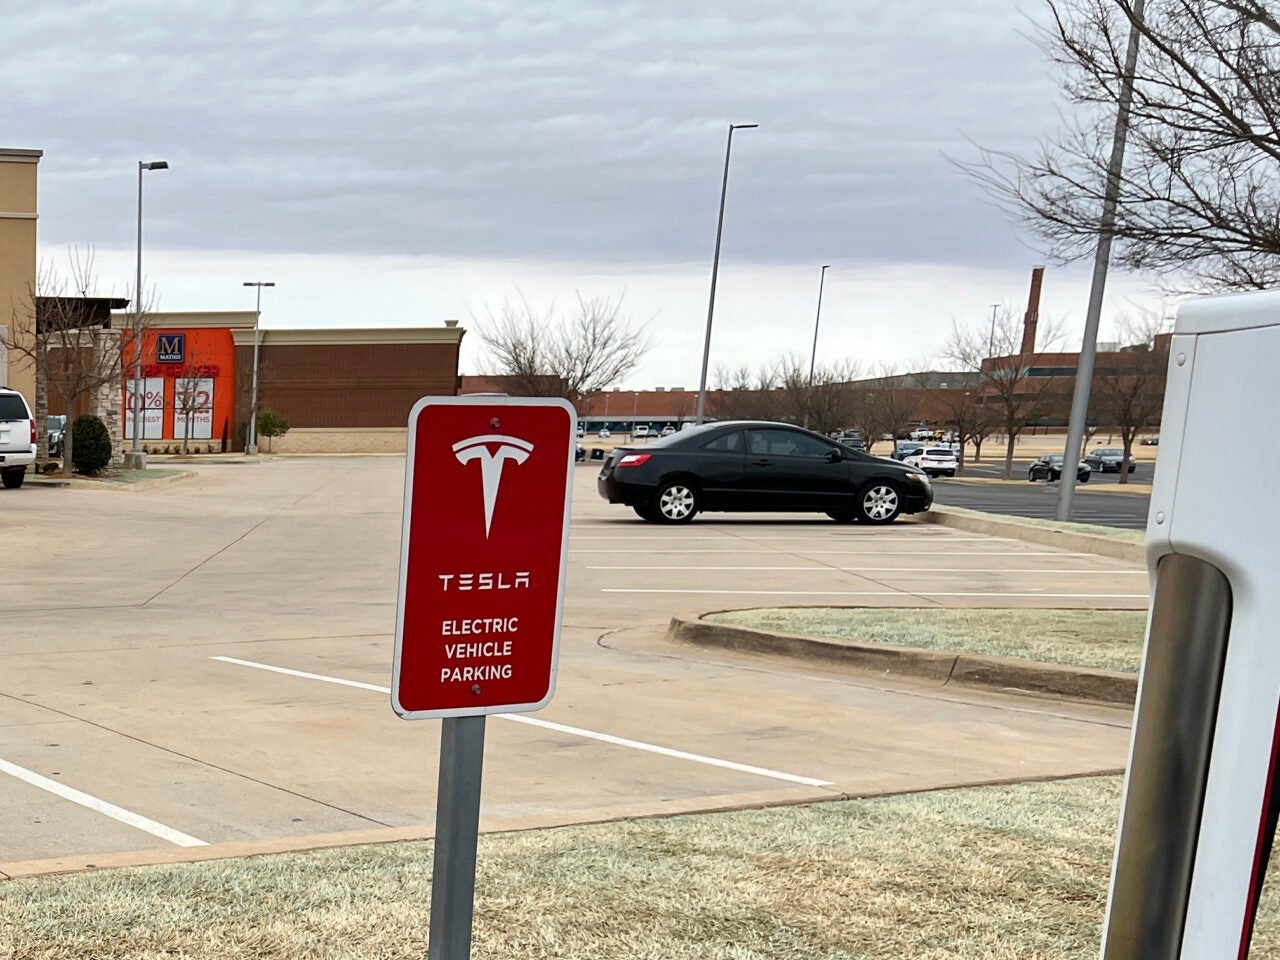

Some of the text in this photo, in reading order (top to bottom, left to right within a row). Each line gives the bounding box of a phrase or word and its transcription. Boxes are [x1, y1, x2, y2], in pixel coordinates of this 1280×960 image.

[159, 337, 181, 354] M
[127, 390, 162, 414] 0%
[438, 571, 530, 591] TESLA
[441, 617, 519, 636] ELECTRIC
[444, 641, 513, 659] VEHICLE
[440, 664, 513, 683] PARKING
